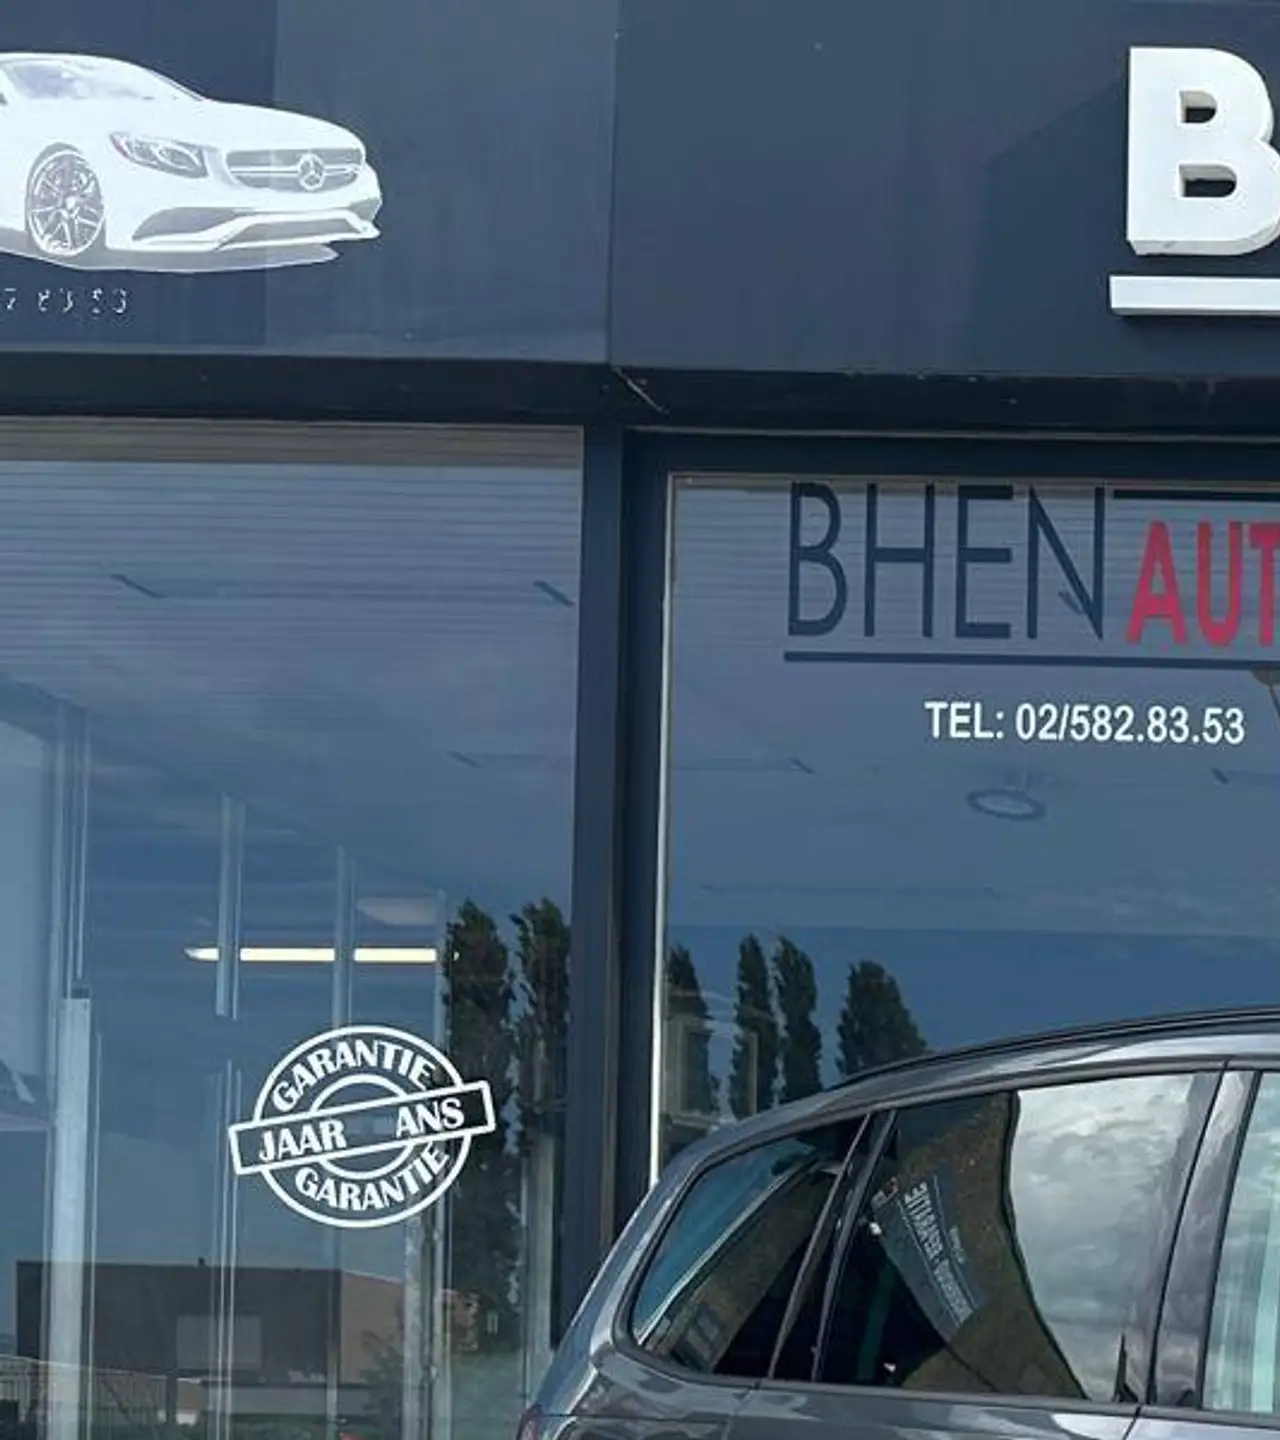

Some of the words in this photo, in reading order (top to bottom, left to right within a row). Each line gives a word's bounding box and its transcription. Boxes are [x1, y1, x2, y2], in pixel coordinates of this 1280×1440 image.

[788, 481, 1105, 640] BHEN
[925, 701, 1004, 739] TEL:
[1015, 702, 1245, 744] 02/582.83.53
[271, 1039, 436, 1112] GARANTIE
[258, 1119, 347, 1161] JAAR
[396, 1098, 465, 1137] ANS
[295, 1143, 450, 1211] GARANTIE
